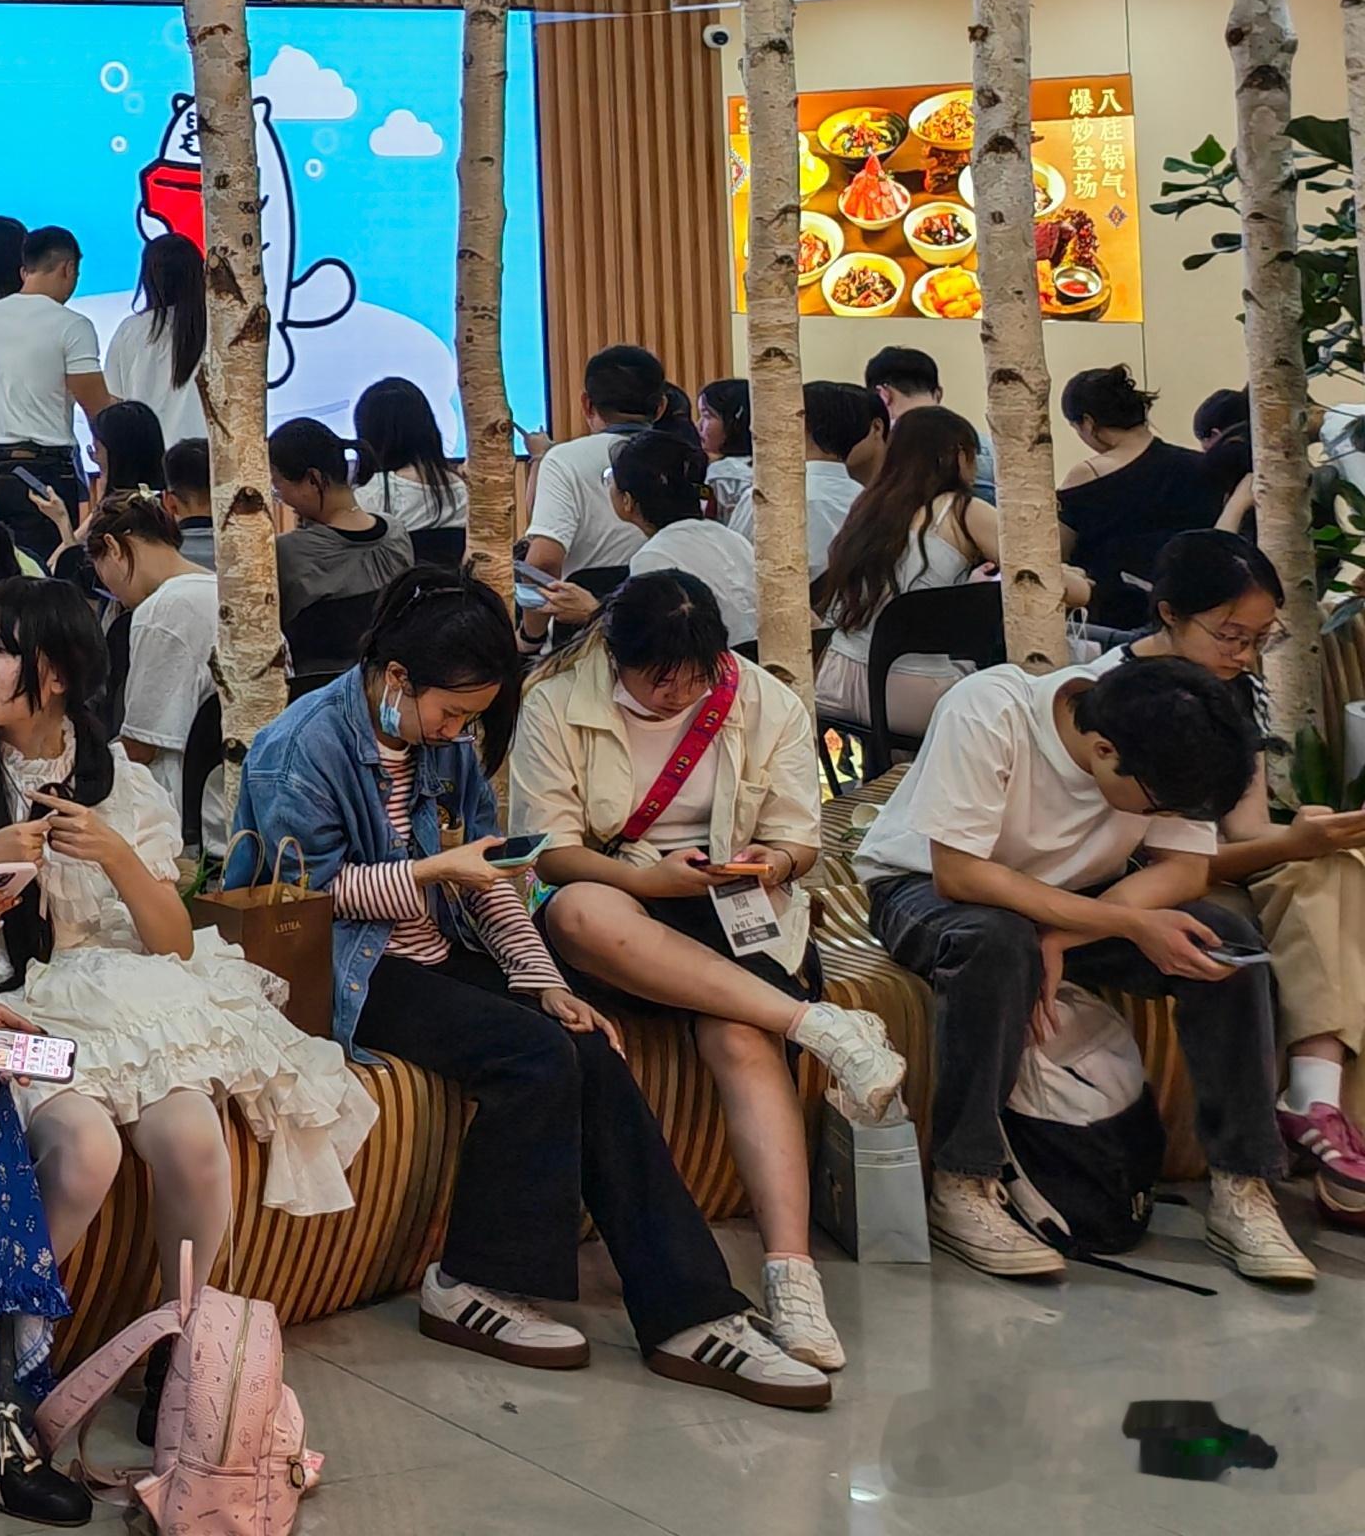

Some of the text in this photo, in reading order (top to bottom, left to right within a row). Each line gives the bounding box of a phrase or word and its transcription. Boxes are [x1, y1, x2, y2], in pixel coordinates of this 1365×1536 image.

[1069, 87, 1099, 200] 爆炒登场
[1098, 88, 1126, 199] 八桂锅气
